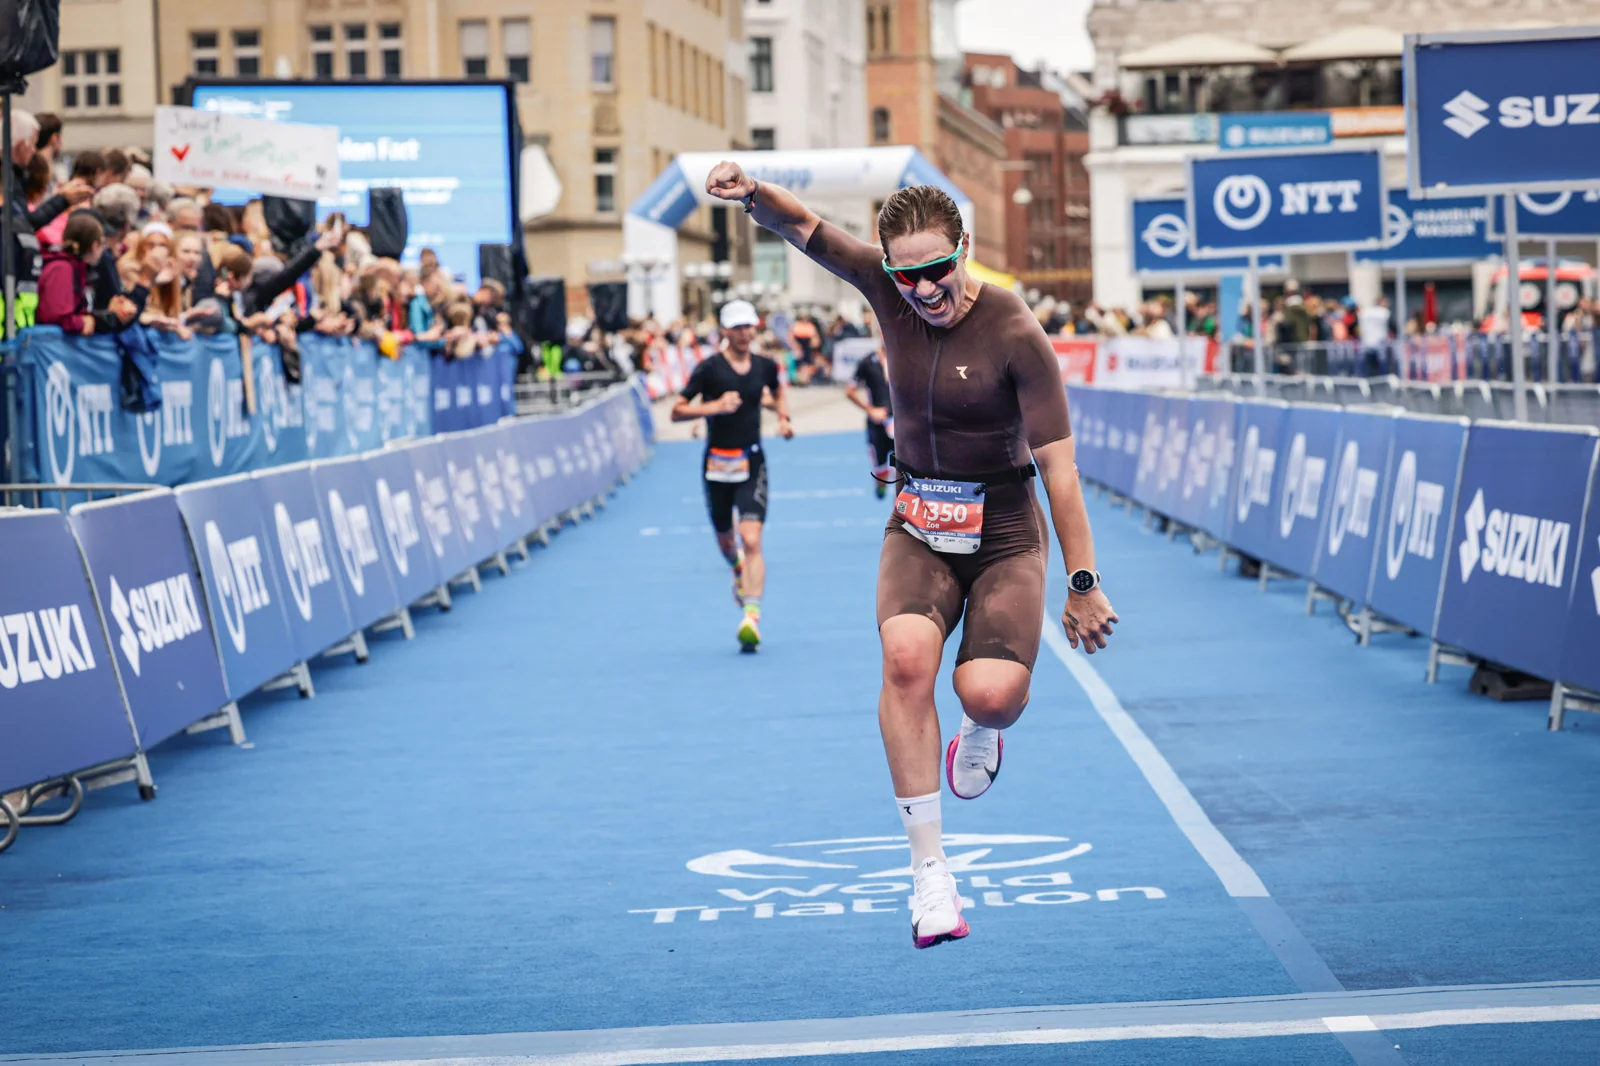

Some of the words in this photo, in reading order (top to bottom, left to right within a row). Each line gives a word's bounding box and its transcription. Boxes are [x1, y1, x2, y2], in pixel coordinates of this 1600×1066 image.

[1498, 92, 1600, 129] SUZ
[1279, 179, 1362, 216] NTT
[921, 483, 962, 494] SUZUKI
[926, 521, 940, 529] Zoe
[1481, 508, 1571, 588] SUZUKI
[129, 573, 203, 654] SUZUKI
[717, 872, 1073, 900] Wold
